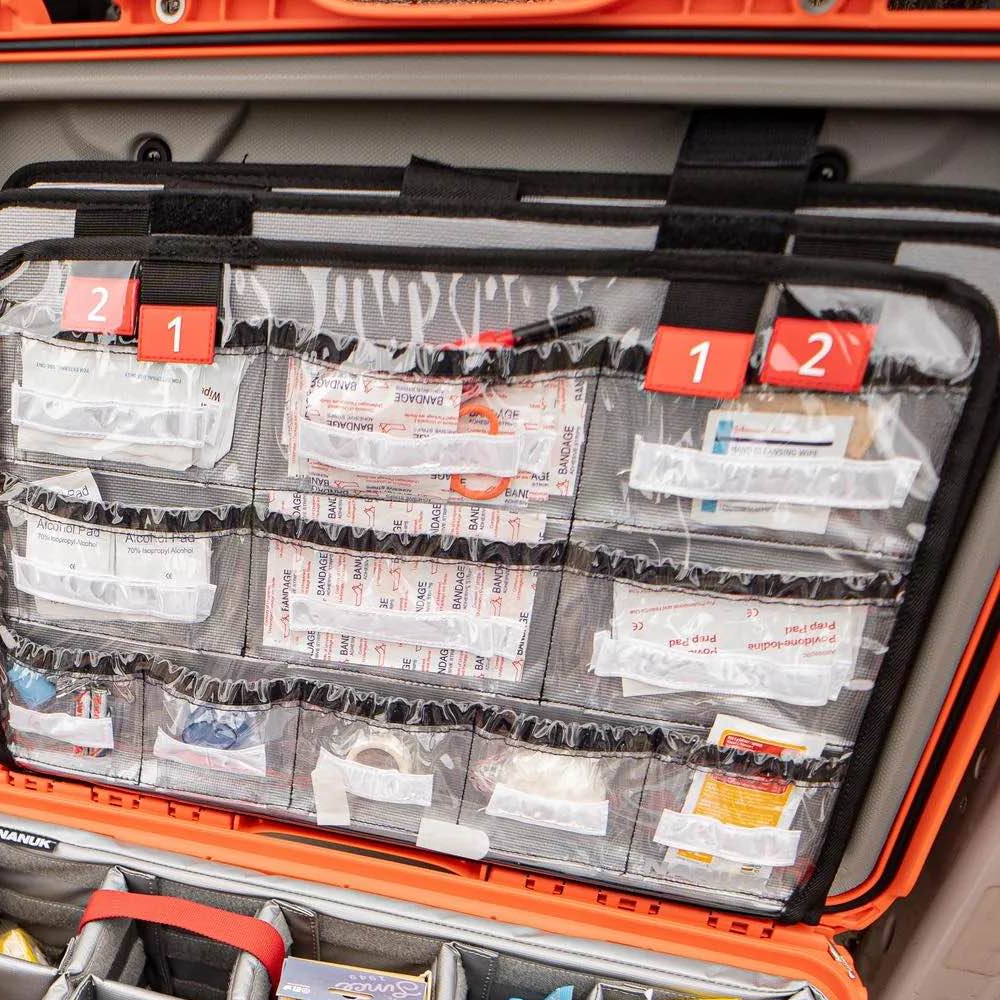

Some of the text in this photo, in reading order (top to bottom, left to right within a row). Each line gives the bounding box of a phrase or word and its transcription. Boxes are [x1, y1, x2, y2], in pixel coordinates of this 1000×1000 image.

[87, 287, 109, 322] 2
[167, 316, 183, 353] 1
[689, 341, 711, 384] 1
[798, 332, 833, 377] 2
[395, 392, 444, 406] BANDAGE
[327, 420, 374, 432] BANDAGE
[558, 425, 575, 475] BANDAGE
[317, 553, 328, 596] BANDAGE
[453, 565, 466, 610] BANDAGE
[669, 634, 718, 648] Prep Pad
[747, 634, 837, 651] Povidone-Iodine
[785, 621, 837, 635] Prep Pad
[335, 981, 422, 998] Since
